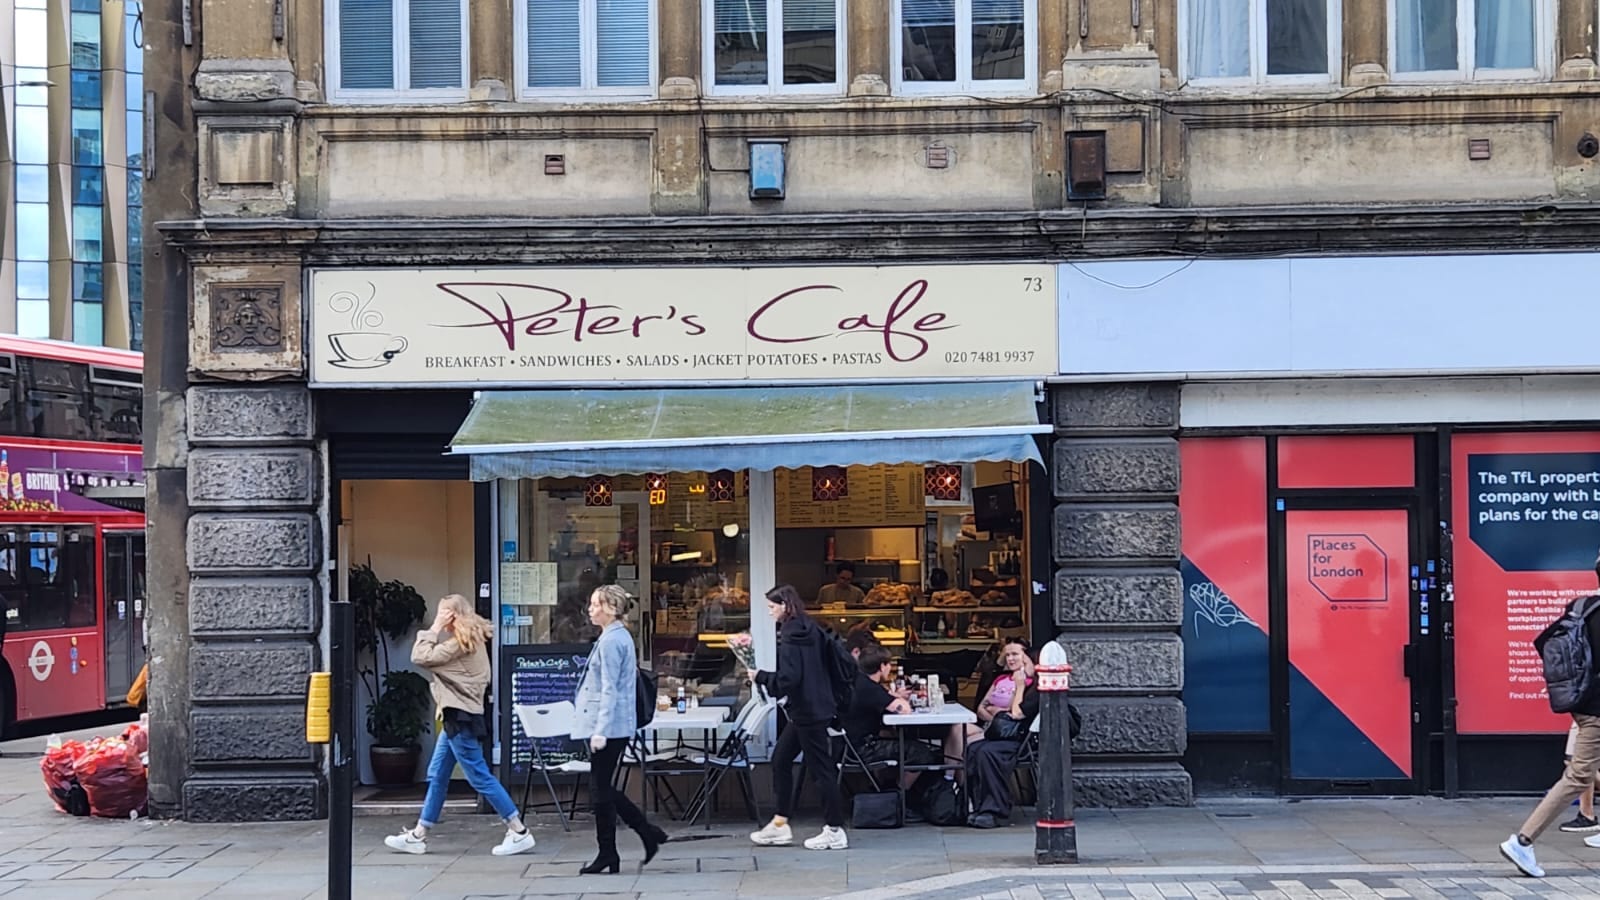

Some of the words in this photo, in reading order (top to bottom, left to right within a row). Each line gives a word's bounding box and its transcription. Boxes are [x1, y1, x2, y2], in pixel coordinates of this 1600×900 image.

[1023, 276, 1043, 292] 73
[428, 282, 706, 351] Peter's
[747, 279, 961, 362] Cafe
[425, 355, 506, 369] BREAKFAST
[519, 354, 612, 367] SANDWICHES
[625, 354, 680, 367] SALADS
[692, 353, 743, 368] JACKET
[747, 353, 818, 366] POTATOES
[832, 352, 882, 365] PASTAS
[944, 351, 967, 364] 020
[970, 351, 1001, 364] 7481
[1003, 350, 1035, 363] 9937
[1478, 471, 1507, 484] The
[1511, 471, 1536, 484] TfL
[1540, 472, 1600, 486] propert
[1479, 492, 1549, 505] company
[1553, 489, 1588, 502] with
[1479, 509, 1520, 524] plans
[1524, 508, 1548, 520] for
[1551, 507, 1577, 520] the
[1582, 509, 1600, 521] ca
[1313, 539, 1356, 550] Places
[1313, 553, 1332, 564] for
[1313, 566, 1363, 577] London
[1529, 589, 1557, 597] working
[1507, 598, 1537, 606] partners
